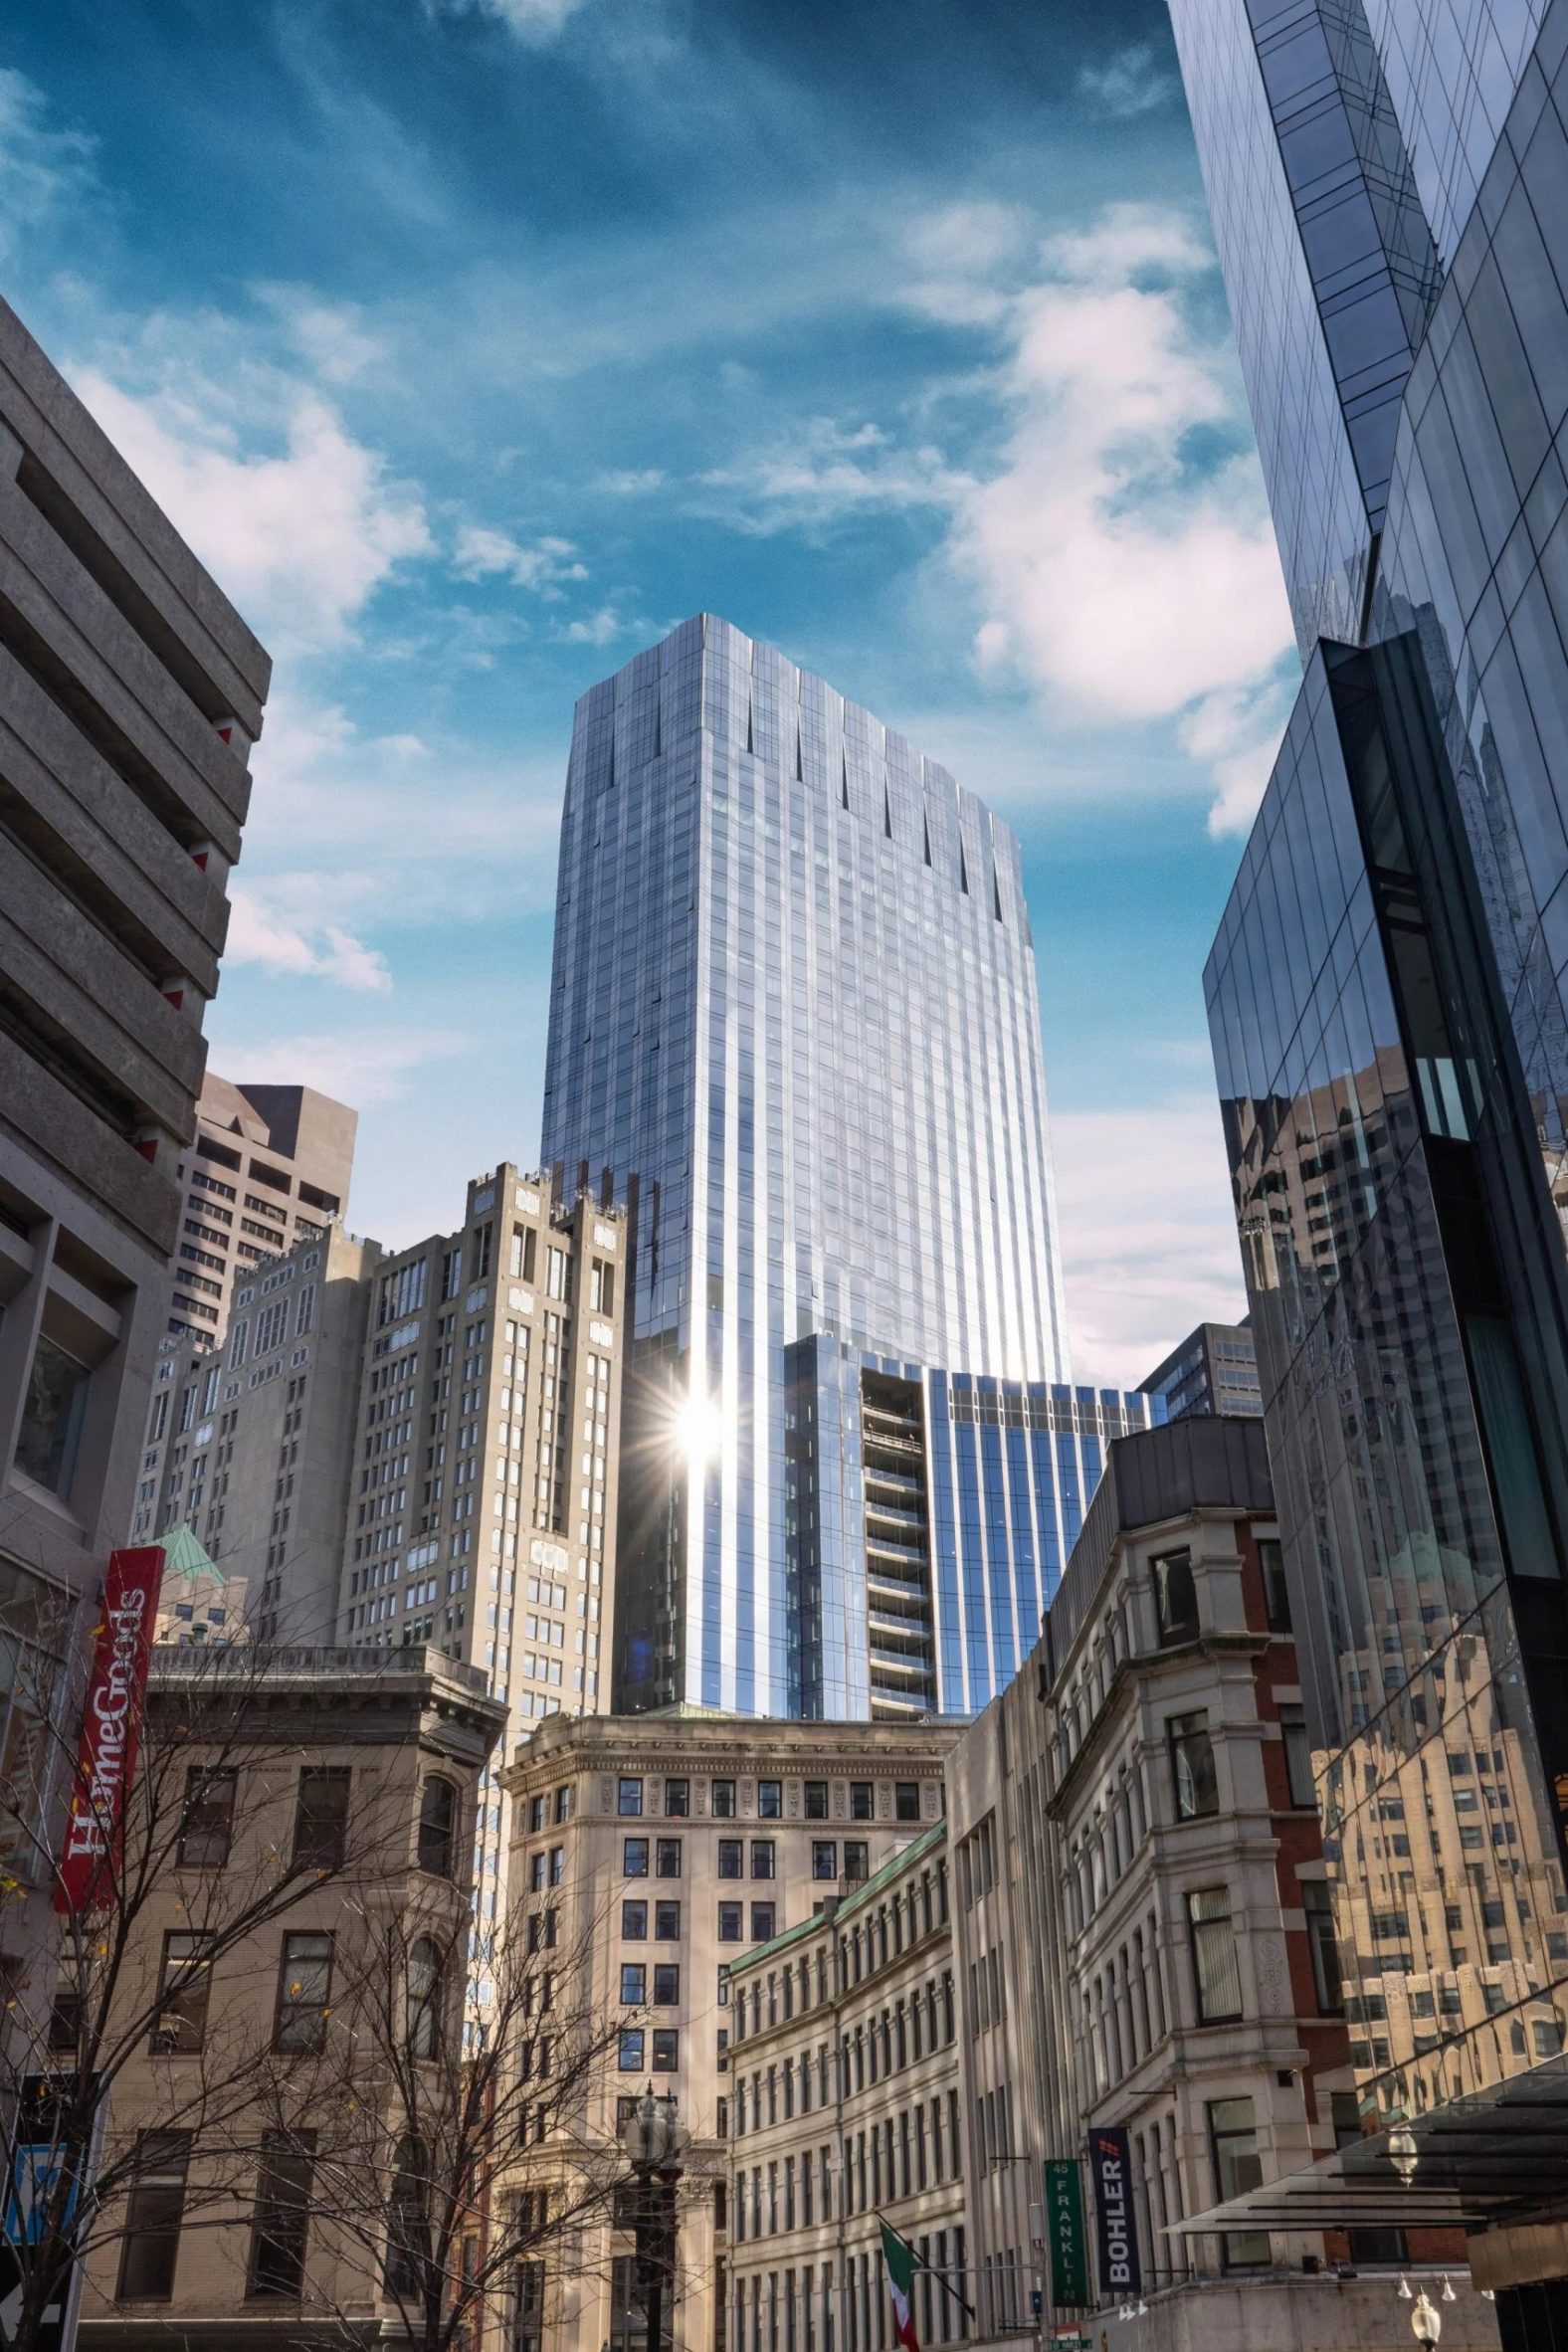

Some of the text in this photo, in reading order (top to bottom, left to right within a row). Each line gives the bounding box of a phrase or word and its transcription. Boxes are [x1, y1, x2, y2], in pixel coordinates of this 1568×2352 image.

[68, 1587, 145, 1859] HomeGoods
[1053, 2163, 1069, 2174] 45
[1101, 2159, 1130, 2283] BOHLER
[1057, 2180, 1076, 2301] FRANKLIN
